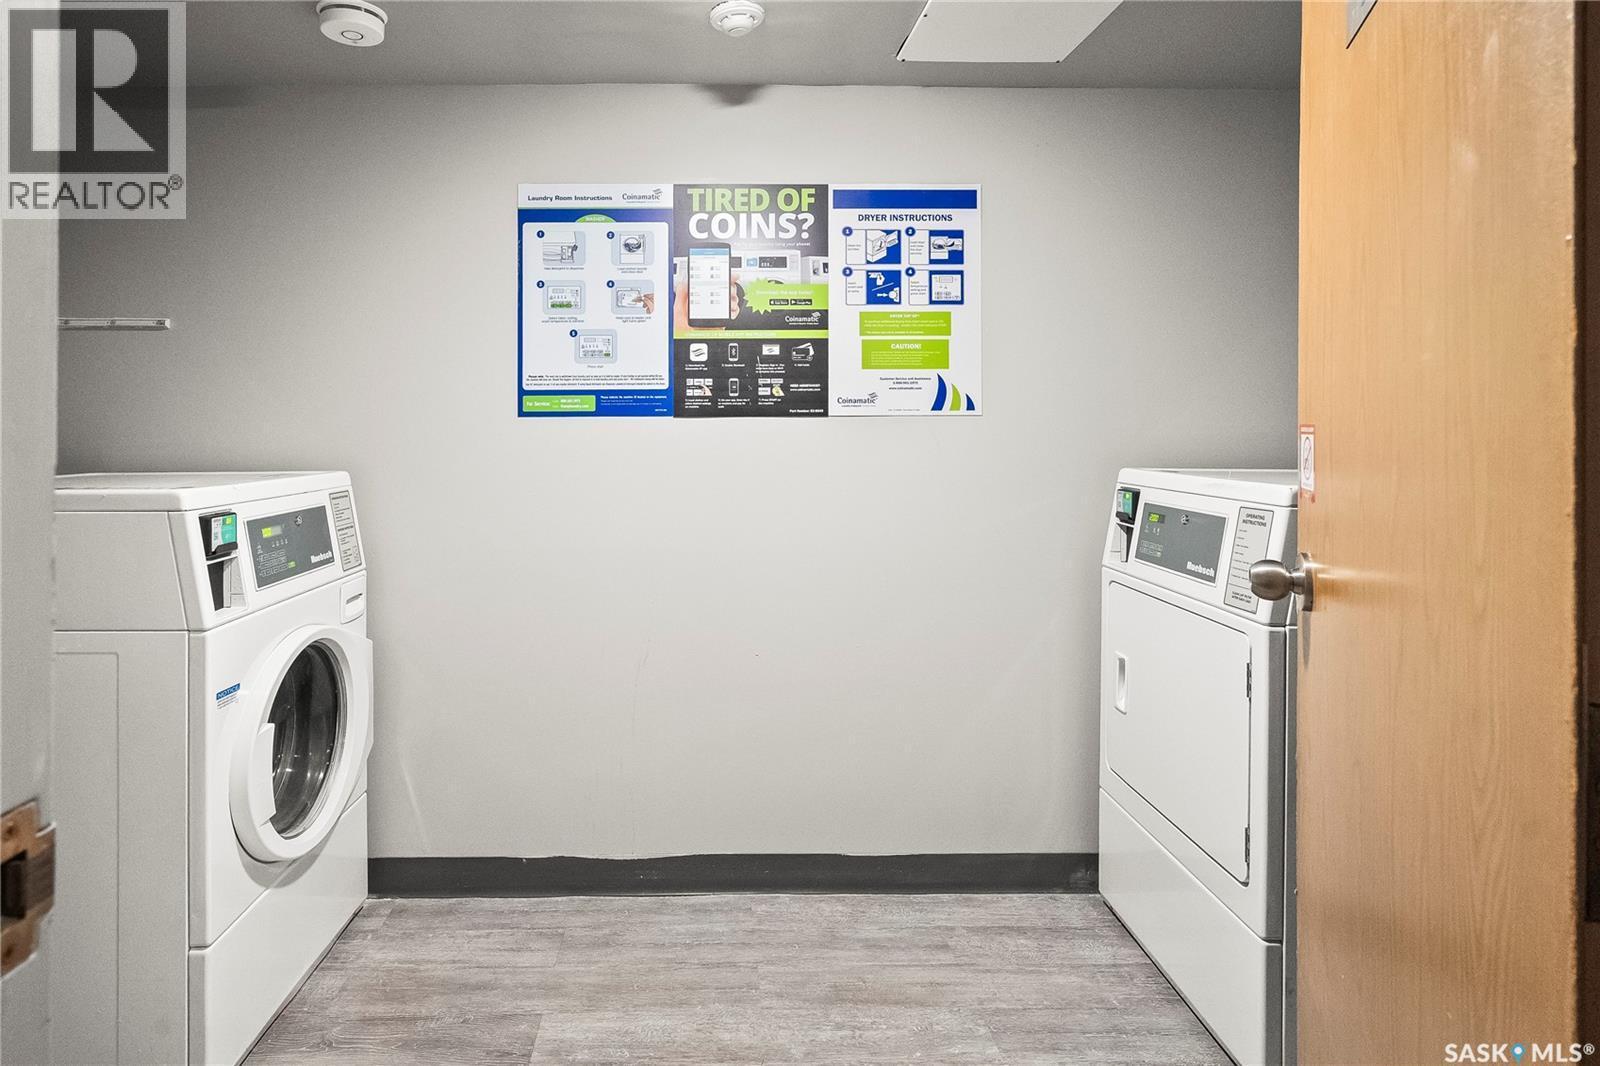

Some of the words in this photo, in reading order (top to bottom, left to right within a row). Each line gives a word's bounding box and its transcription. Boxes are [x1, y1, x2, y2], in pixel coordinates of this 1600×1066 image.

[622, 192, 661, 201] Coinamatic
[687, 187, 770, 212] TIRED
[777, 187, 816, 212] OF
[857, 214, 887, 222] DRYER
[889, 214, 953, 222] INSTRUCTIONS
[688, 212, 815, 239] COINS?
[784, 315, 819, 323] Coinamatic
[836, 396, 877, 405] Coinamatic
[1245, 512, 1265, 520] OPERATING
[1242, 518, 1267, 527] INSTRUCTIONS
[310, 550, 333, 564] Huebsch
[1186, 561, 1215, 578] Huebsch
[217, 684, 240, 699] NOTICE
